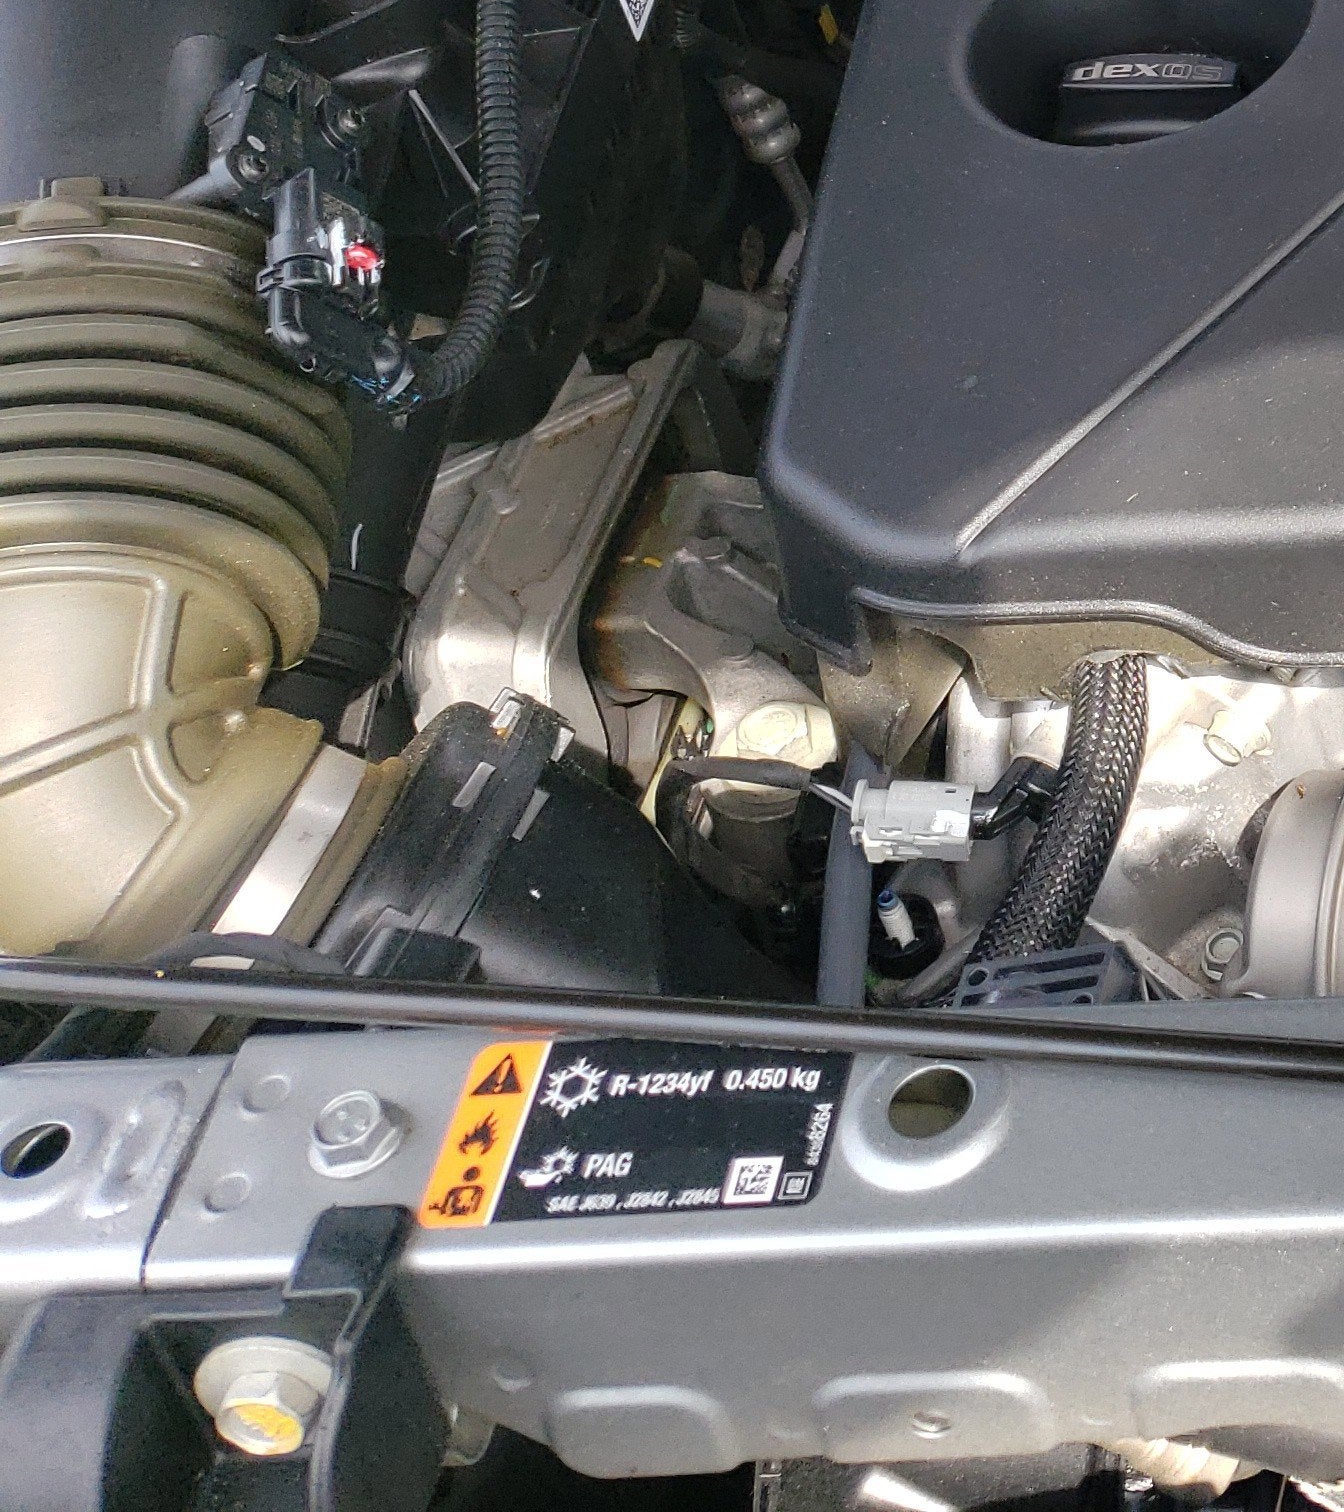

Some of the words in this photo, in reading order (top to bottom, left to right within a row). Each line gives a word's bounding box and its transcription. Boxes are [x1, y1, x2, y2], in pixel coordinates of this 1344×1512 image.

[1072, 61, 1223, 81] dexos
[609, 1068, 714, 1098] R-1234yf
[724, 1066, 789, 1092] 0.450
[789, 1065, 822, 1093] kg
[583, 1150, 634, 1180] PAG
